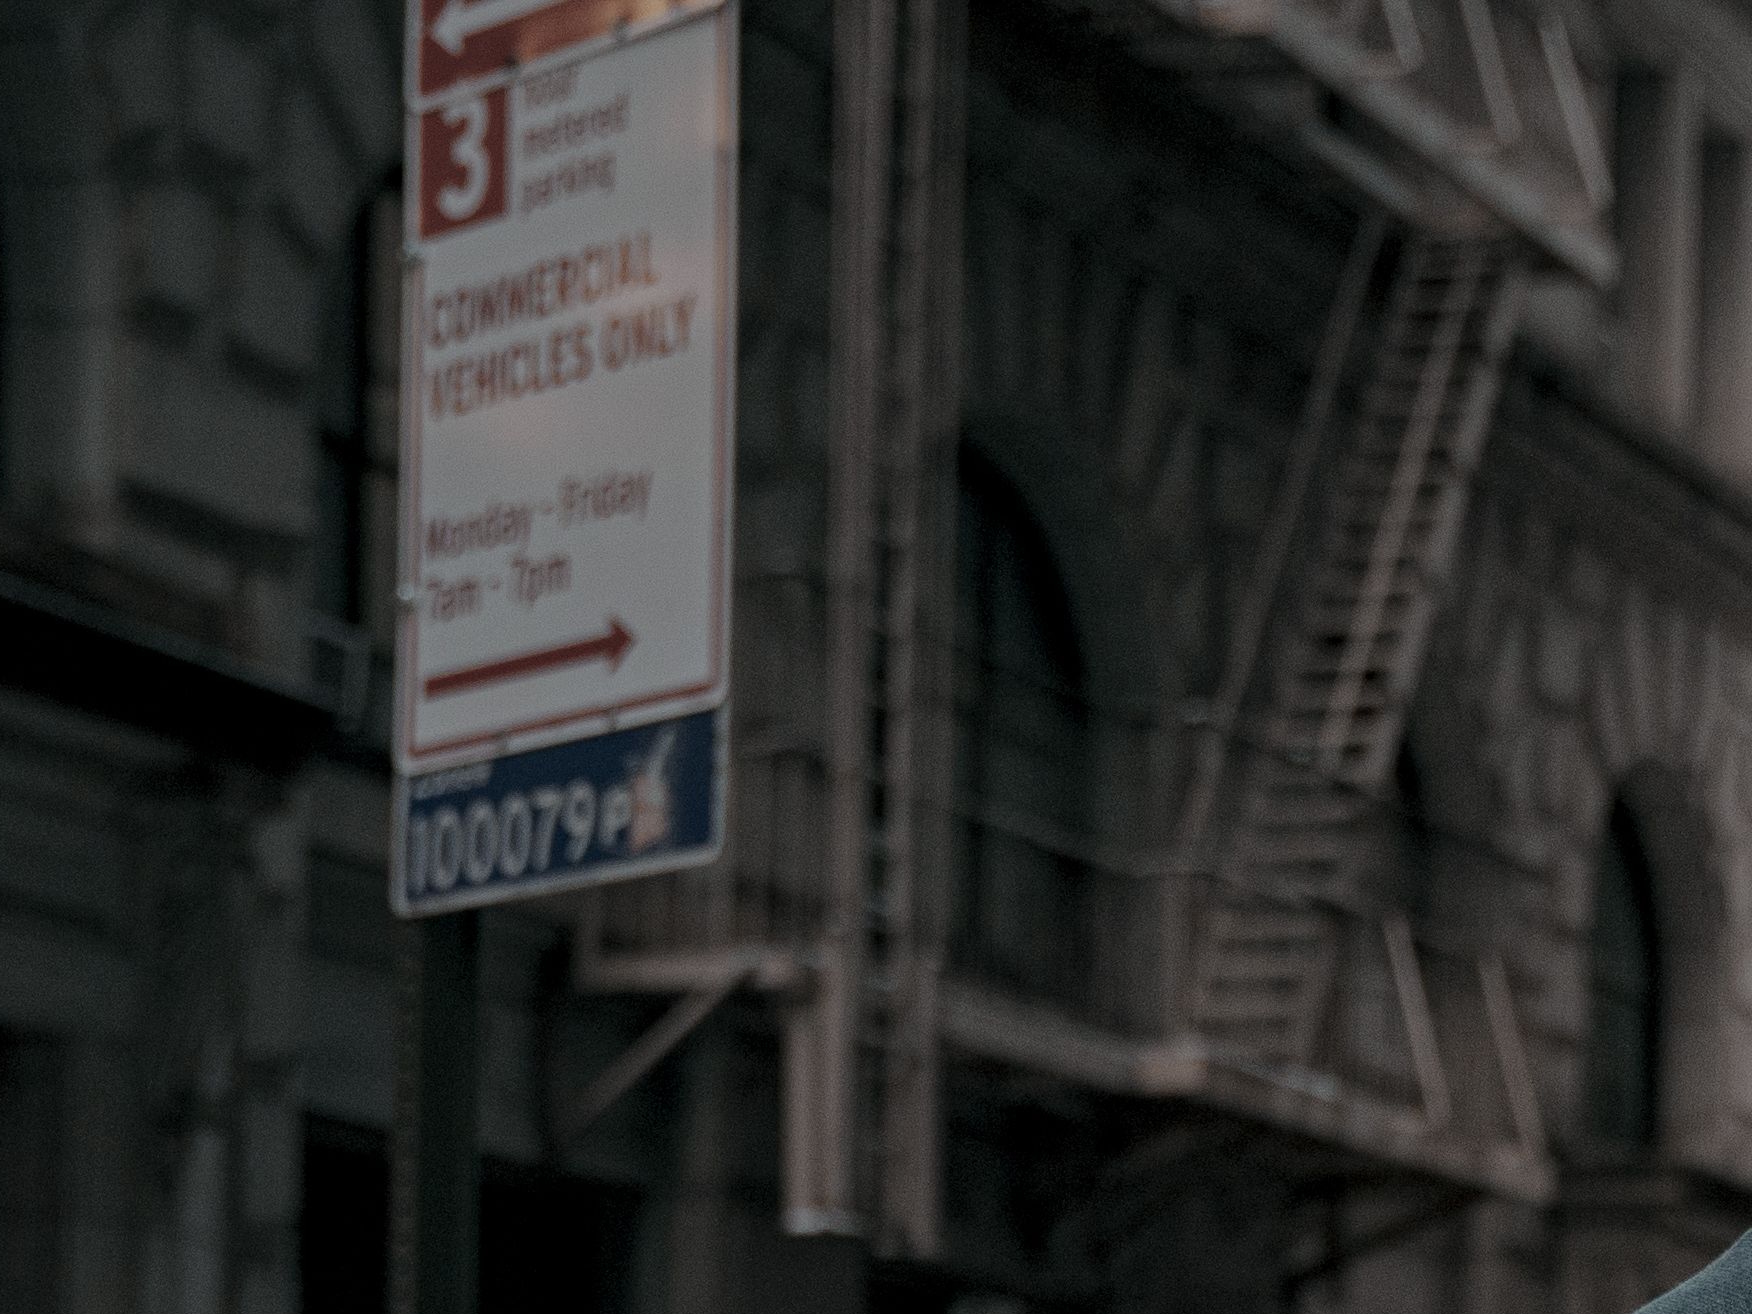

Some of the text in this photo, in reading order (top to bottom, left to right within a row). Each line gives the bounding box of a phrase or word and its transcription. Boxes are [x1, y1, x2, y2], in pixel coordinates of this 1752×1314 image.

[436, 99, 490, 220] 3
[524, 95, 629, 157] metered
[522, 153, 617, 212] parking
[429, 235, 659, 350] COMMERCIAL
[428, 297, 697, 420] VEHICLES ONLY
[426, 508, 531, 558] Monday
[560, 474, 652, 527] Friday
[427, 580, 480, 622] 7am
[513, 557, 570, 606] 7pm
[413, 778, 598, 895] 100079
